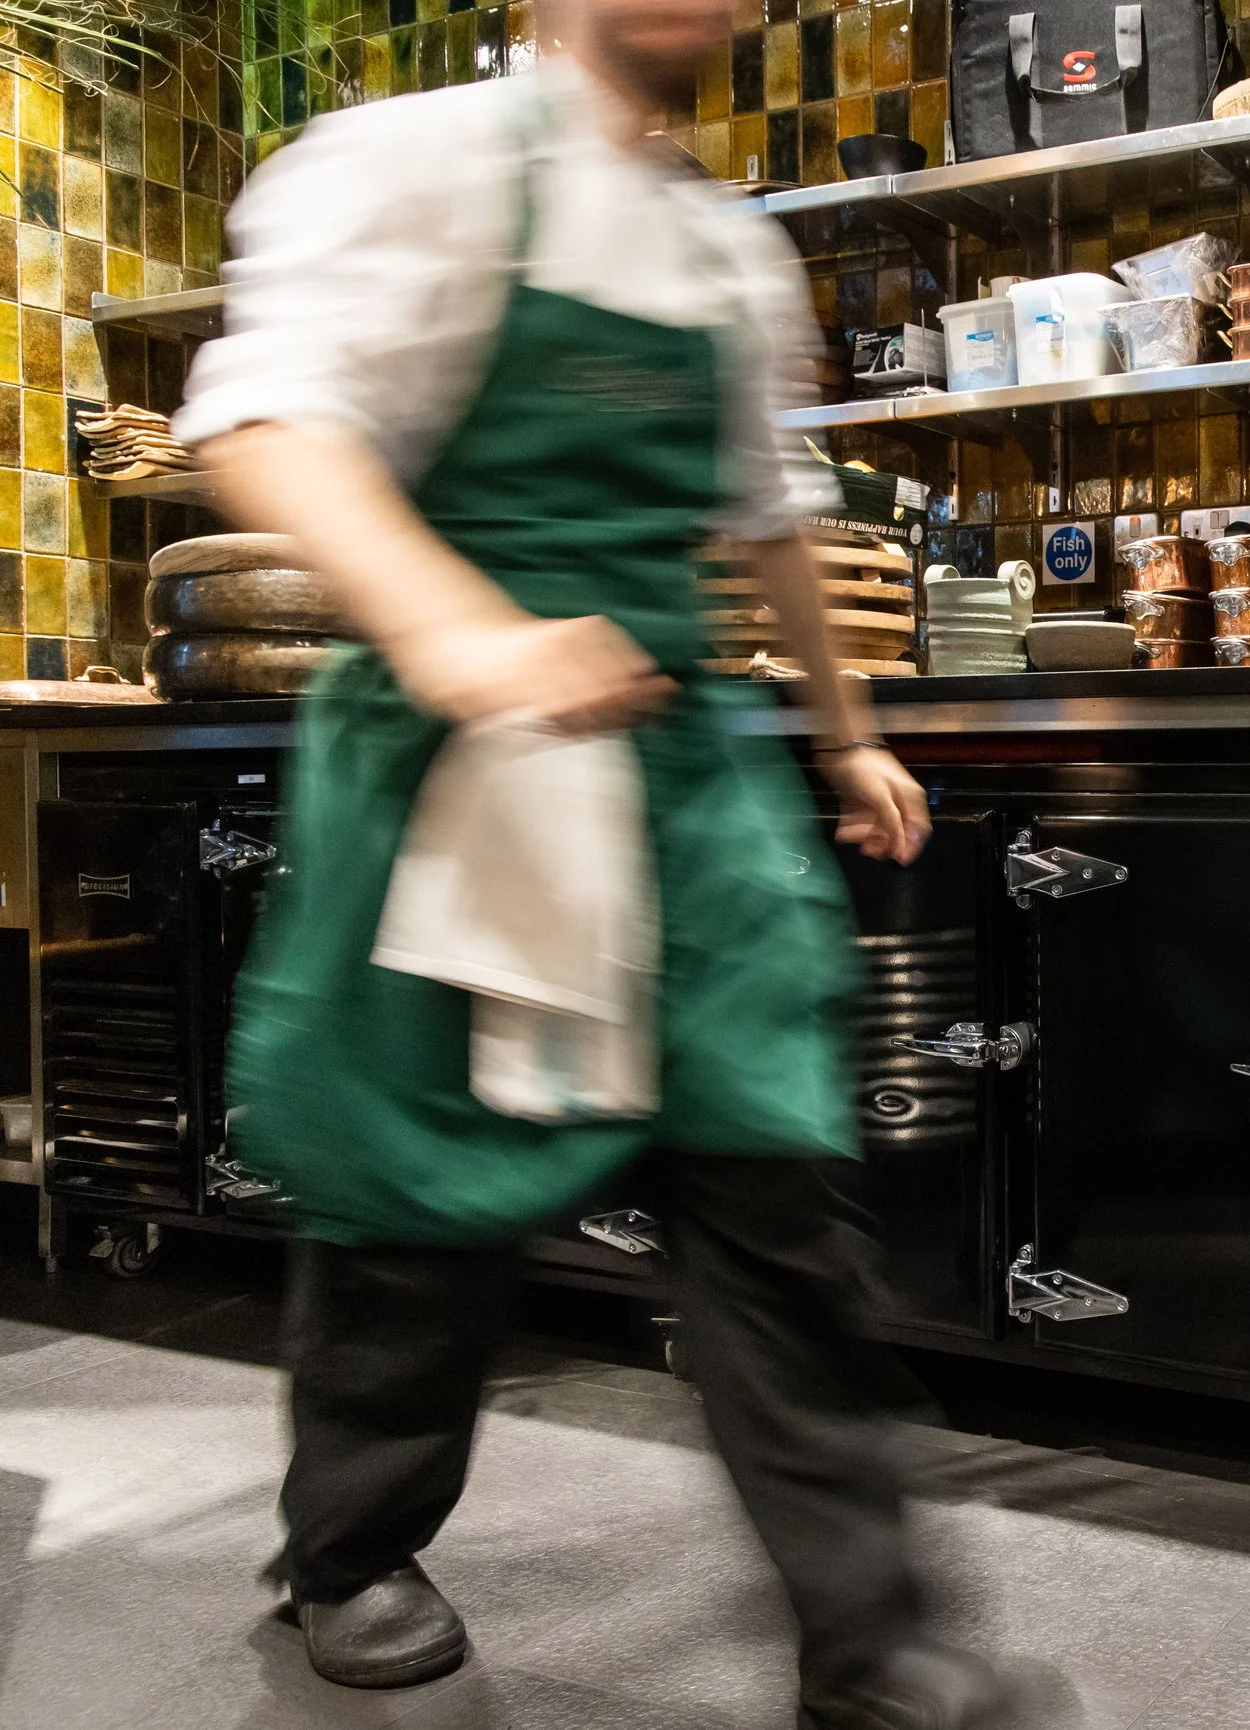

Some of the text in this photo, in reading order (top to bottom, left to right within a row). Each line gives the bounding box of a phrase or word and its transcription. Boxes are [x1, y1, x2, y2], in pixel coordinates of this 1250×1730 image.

[820, 516, 838, 528] OUR
[837, 519, 848, 530] IS
[847, 520, 888, 535] HAPPINESS
[888, 526, 908, 538] YOUR
[1052, 535, 1085, 552] Fish
[1054, 552, 1088, 571] only
[84, 882, 124, 891] precision
